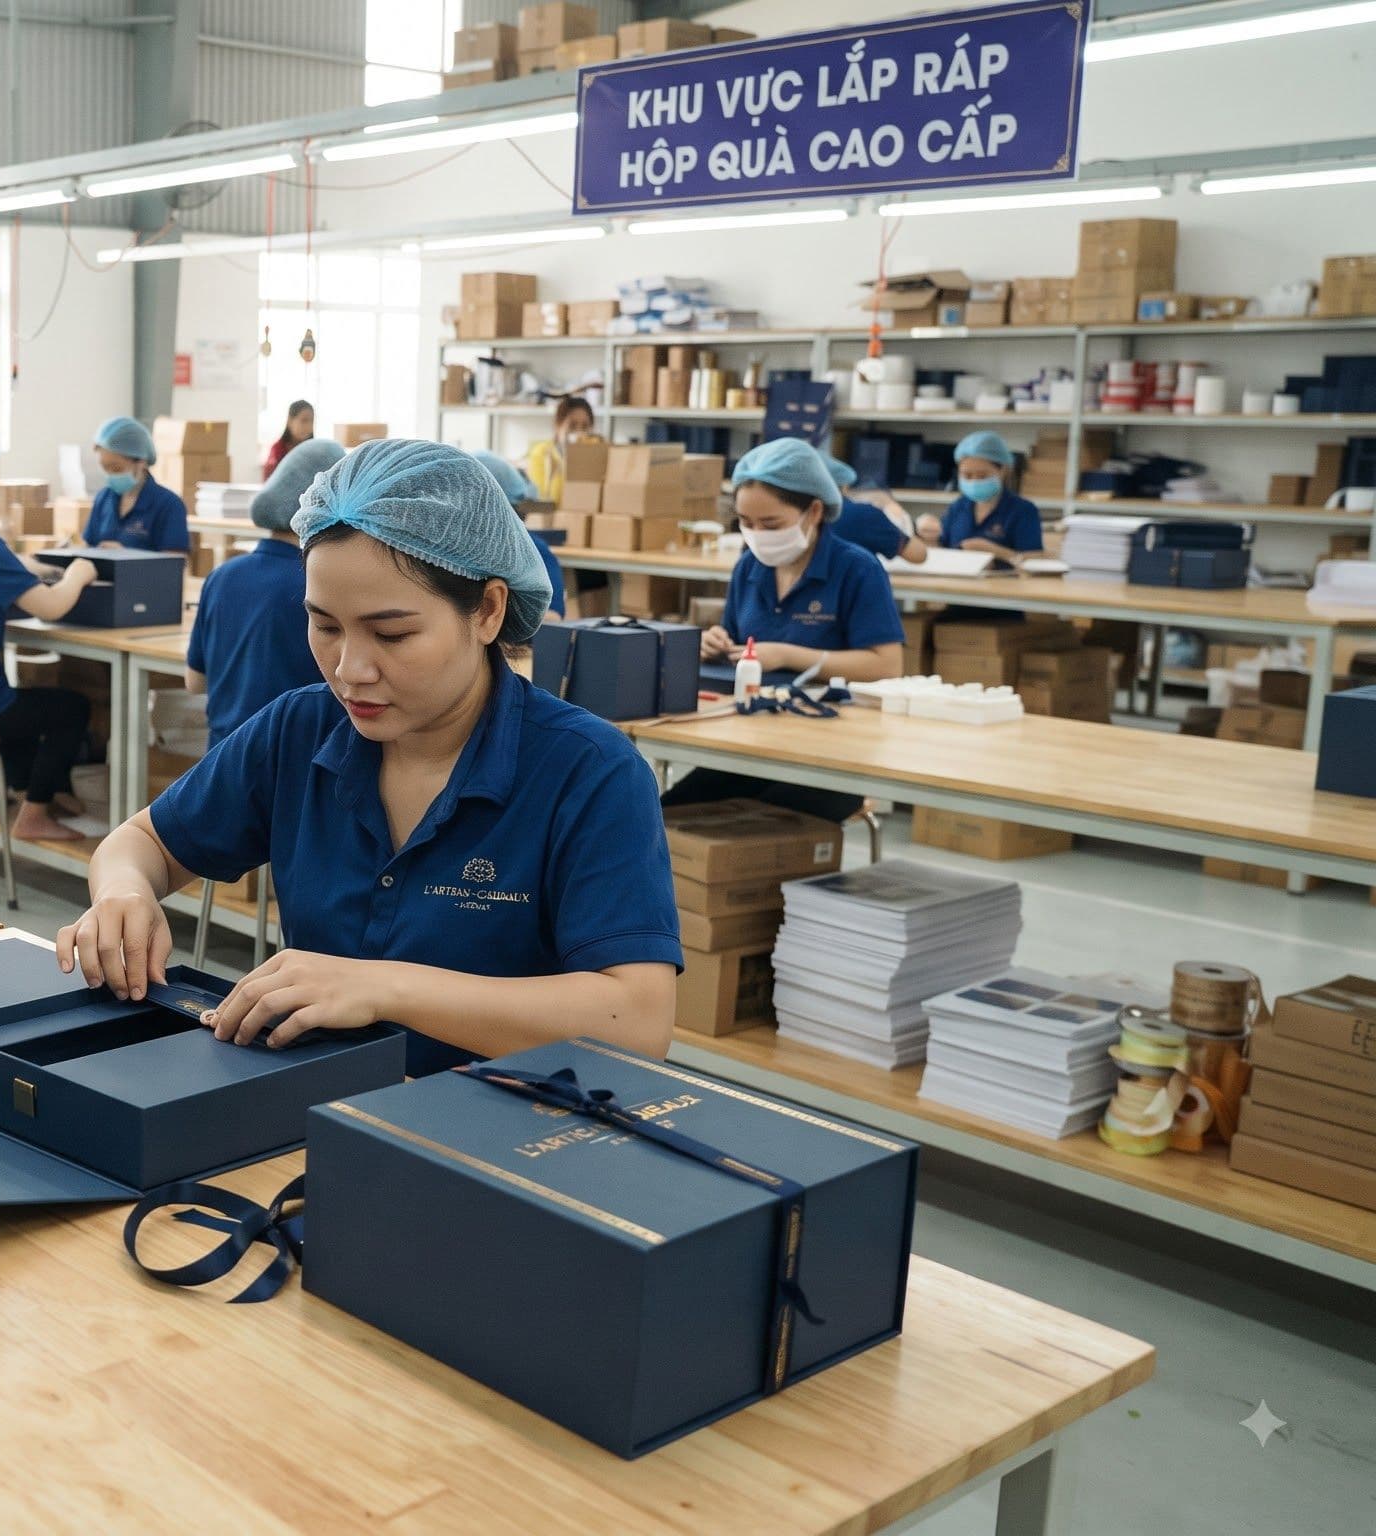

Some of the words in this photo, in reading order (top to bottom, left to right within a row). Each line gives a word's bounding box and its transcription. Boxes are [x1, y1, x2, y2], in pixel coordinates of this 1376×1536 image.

[627, 82, 703, 129] KHU
[716, 66, 803, 127] VỰC
[817, 38, 899, 108] LẮP
[913, 33, 1009, 97] RÁP
[619, 138, 698, 196] HỘP
[707, 124, 795, 182] QUÀ
[808, 124, 904, 173] CAO
[917, 94, 1017, 163] CẤP
